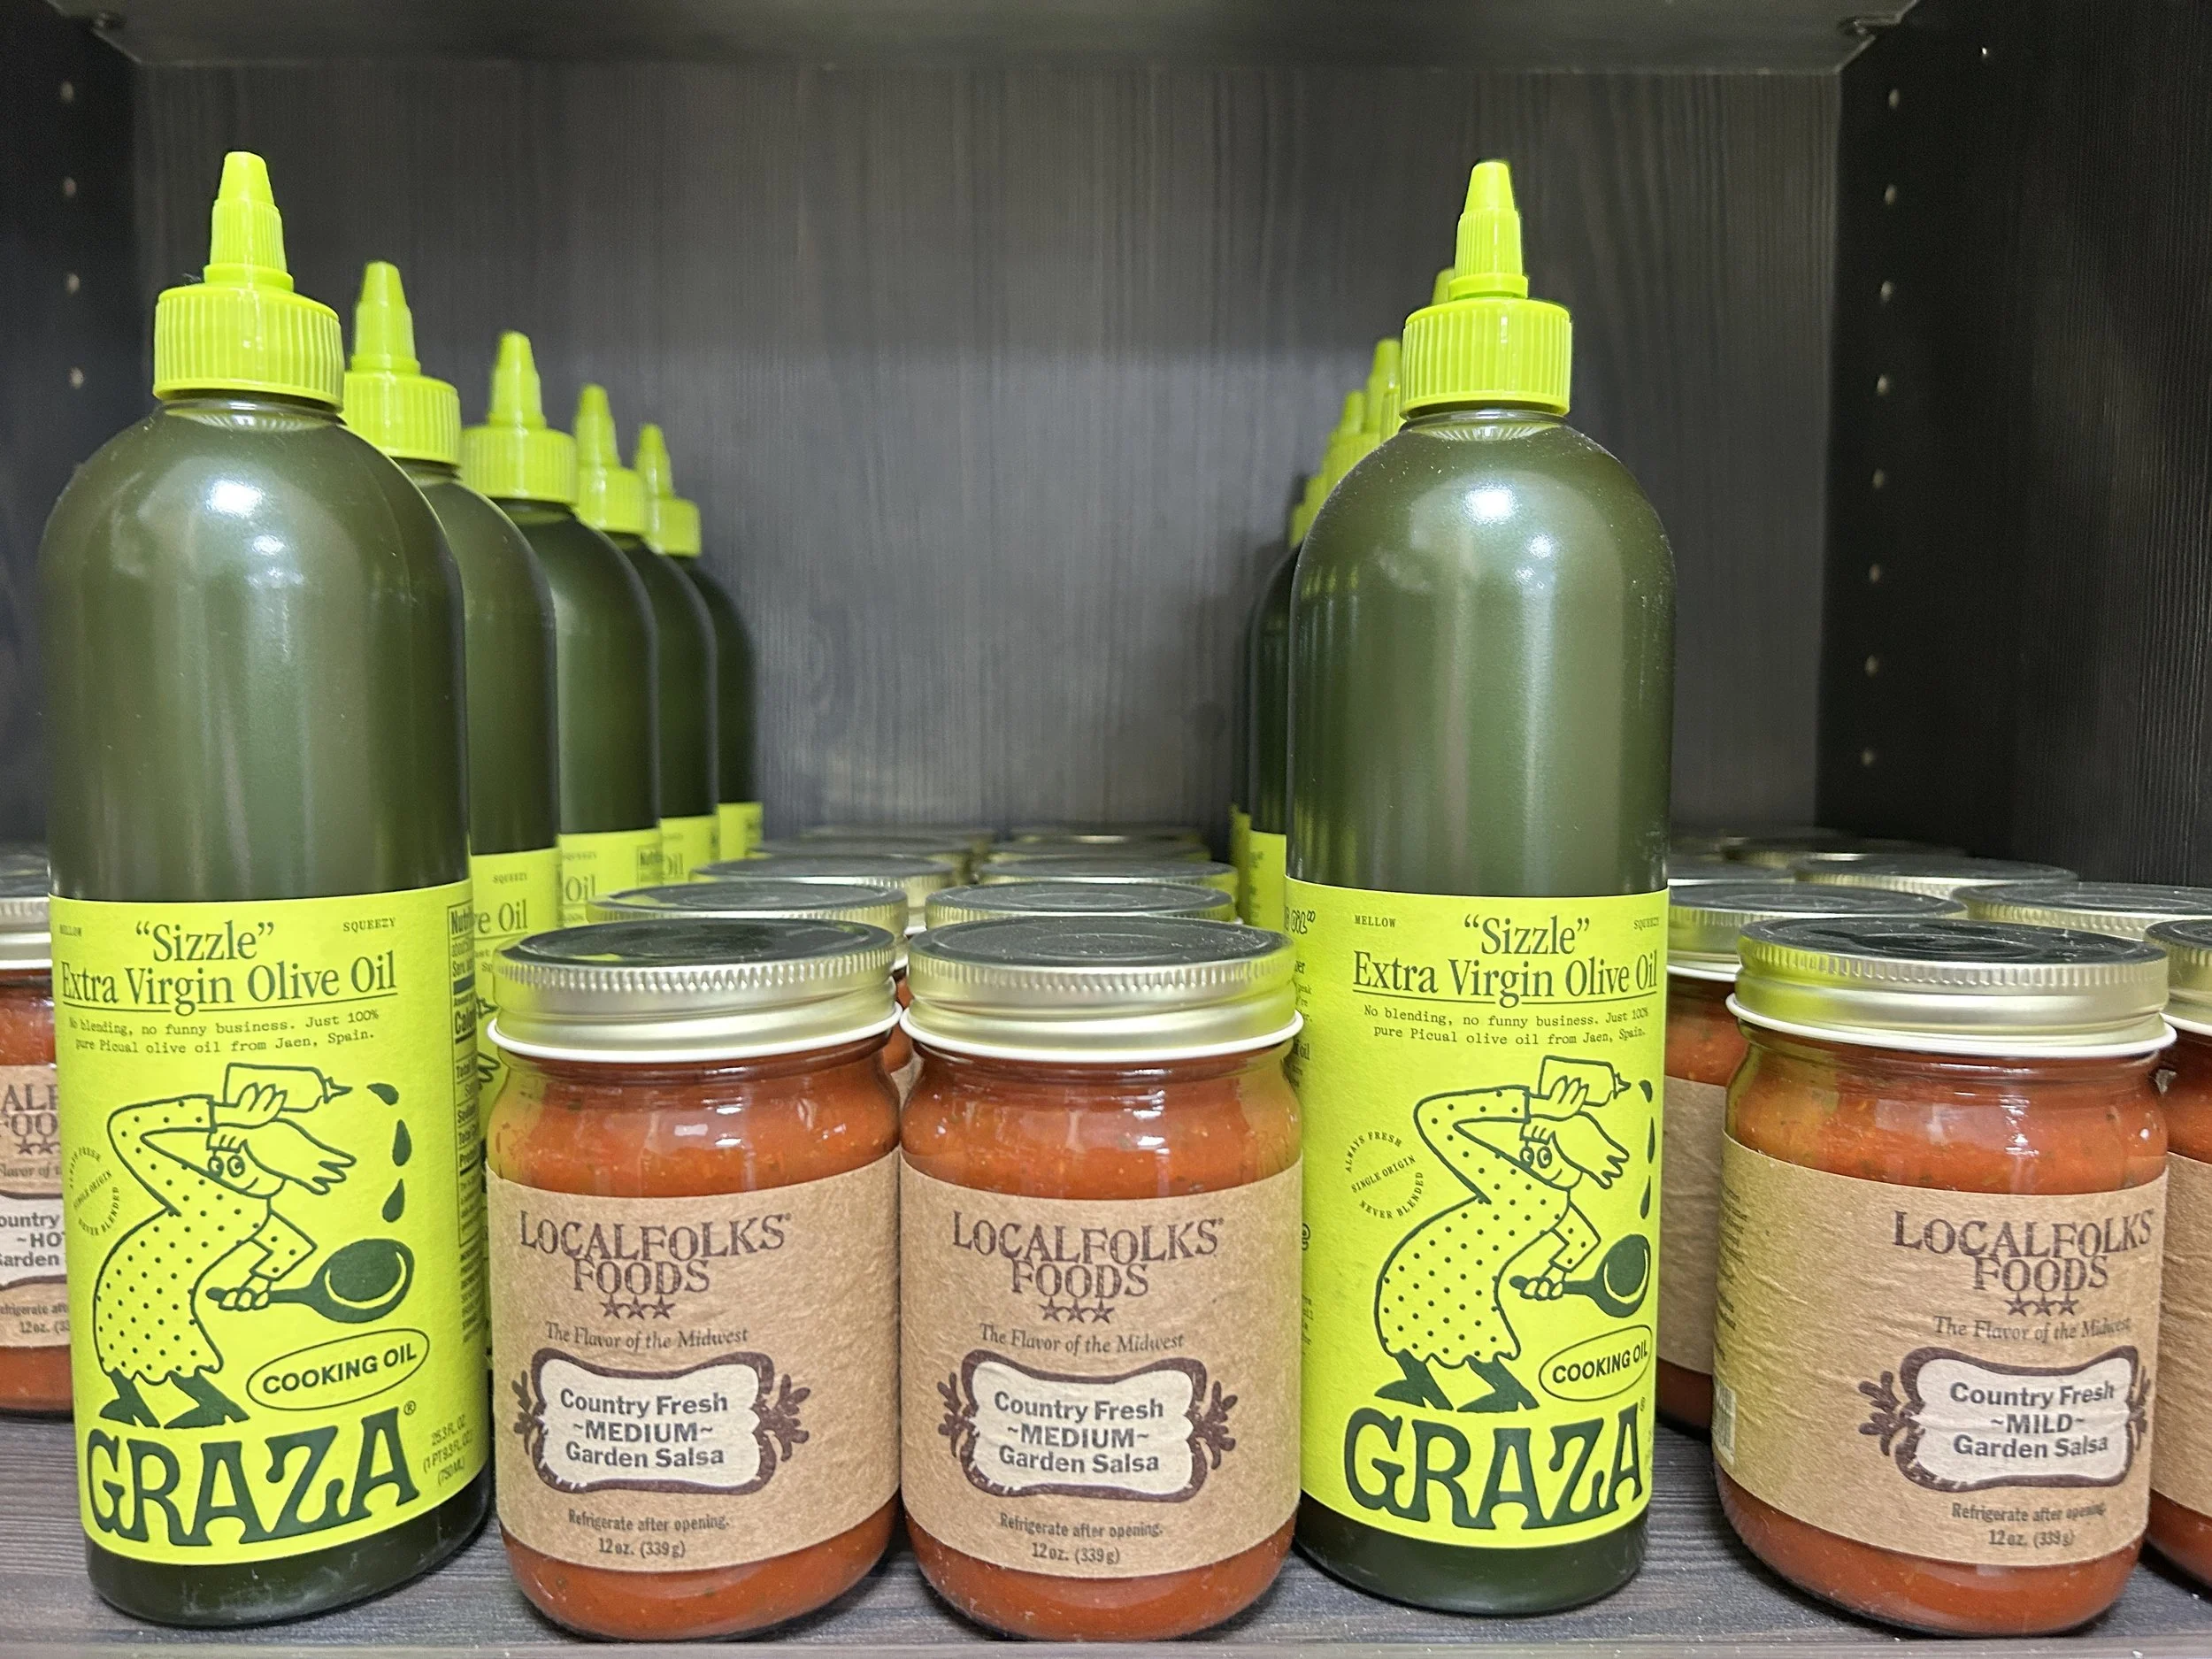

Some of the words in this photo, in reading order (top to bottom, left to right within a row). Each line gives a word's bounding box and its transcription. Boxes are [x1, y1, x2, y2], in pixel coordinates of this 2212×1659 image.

[566, 874, 595, 901] Oil
[343, 917, 396, 933] SQUEEZY
[498, 899, 528, 932] Oil
[1355, 915, 1396, 928] MELLOW
[61, 961, 119, 1003] Extra
[125, 967, 234, 1016] Virgin
[248, 960, 340, 1002] Olive
[350, 950, 396, 993] Oil
[1354, 950, 1439, 994] Extra
[1448, 959, 1554, 1009] Virgin
[1565, 956, 1630, 997] Olive
[1636, 949, 1657, 990] Oil
[80, 1019, 133, 1036] blending,
[142, 1024, 157, 1035] no
[165, 1024, 206, 1037] funny
[216, 1020, 295, 1034] business.
[305, 1015, 340, 1028] Just
[348, 1009, 380, 1025] 100%
[1364, 1004, 1378, 1016] No
[1385, 1007, 1452, 1025] blending,
[1463, 1017, 1479, 1025] no
[1488, 1016, 1528, 1028] funny
[1536, 1016, 1599, 1026] business.
[1606, 1012, 1627, 1023] Just
[1632, 1007, 1648, 1019] 100%
[75, 1038, 95, 1049] pure
[100, 1039, 138, 1054] Picual
[146, 1040, 186, 1054] olive
[195, 1041, 221, 1053] oil
[231, 1041, 267, 1052] from
[275, 1036, 319, 1049] Jaen,
[327, 1029, 374, 1045] Spain.
[1374, 1025, 1402, 1038] pure
[1410, 1027, 1457, 1042] Picual
[1466, 1033, 1508, 1044] olive
[1515, 1033, 1539, 1045] oil
[1548, 1033, 1577, 1044] from
[1583, 1032, 1613, 1043] Jaen,
[1619, 1026, 1646, 1041] Spain.
[1345, 1135, 1365, 1173] ALWAYS
[1368, 1132, 1402, 1148] FRESH
[1351, 1172, 1381, 1194] SINGLE
[1382, 1154, 1416, 1177] ORIGIN
[1359, 1199, 1394, 1219] NEVER
[1395, 1171, 1424, 1217] BLENDED
[1893, 1210, 2154, 1259] LOCALFOLKS
[573, 1258, 710, 1295] FOODS
[1010, 1257, 1148, 1298] FOODS
[1973, 1254, 2108, 1293] FOODS
[0, 1302, 49, 1317] efrigerate
[545, 1321, 570, 1342] The
[575, 1325, 620, 1348] Flavor
[626, 1330, 641, 1352] of
[646, 1331, 671, 1348] the
[678, 1328, 749, 1348] Midwest
[979, 1323, 1006, 1344] The
[1010, 1328, 1061, 1350] Flavor
[1064, 1334, 1081, 1356] of
[1085, 1334, 1110, 1353] the
[1117, 1333, 1185, 1352] Midwest
[1933, 1316, 1967, 1337] The
[1974, 1319, 2028, 1340] Flavor
[2035, 1322, 2051, 1343] of
[2054, 1322, 2077, 1339] the
[263, 1355, 378, 1395] COOKING
[383, 1341, 417, 1369] OIL
[1552, 1349, 1631, 1385] COOKING
[1633, 1340, 1648, 1363] OIL
[560, 1388, 650, 1417] Country
[657, 1392, 728, 1415] Fresh
[995, 1391, 1088, 1424] Country
[1094, 1398, 1164, 1420] Fresh
[1950, 1382, 2053, 1410] Country
[2059, 1380, 2115, 1406] Fresh
[566, 1442, 649, 1468] Garden
[656, 1448, 724, 1468] Salsa
[999, 1446, 1085, 1473] Garden
[1092, 1452, 1159, 1473] Salsa
[1953, 1434, 2048, 1459] Garden
[2055, 1435, 2108, 1457] Salsa
[568, 1509, 634, 1532] Refrigerate
[638, 1516, 669, 1532] after
[674, 1514, 730, 1532] opening.
[1000, 1512, 1068, 1536] Refrigerate
[1072, 1523, 1104, 1538] after
[1109, 1522, 1164, 1540] opening.
[1952, 1502, 2029, 1523] Refrigerate
[2033, 1506, 2063, 1522] after
